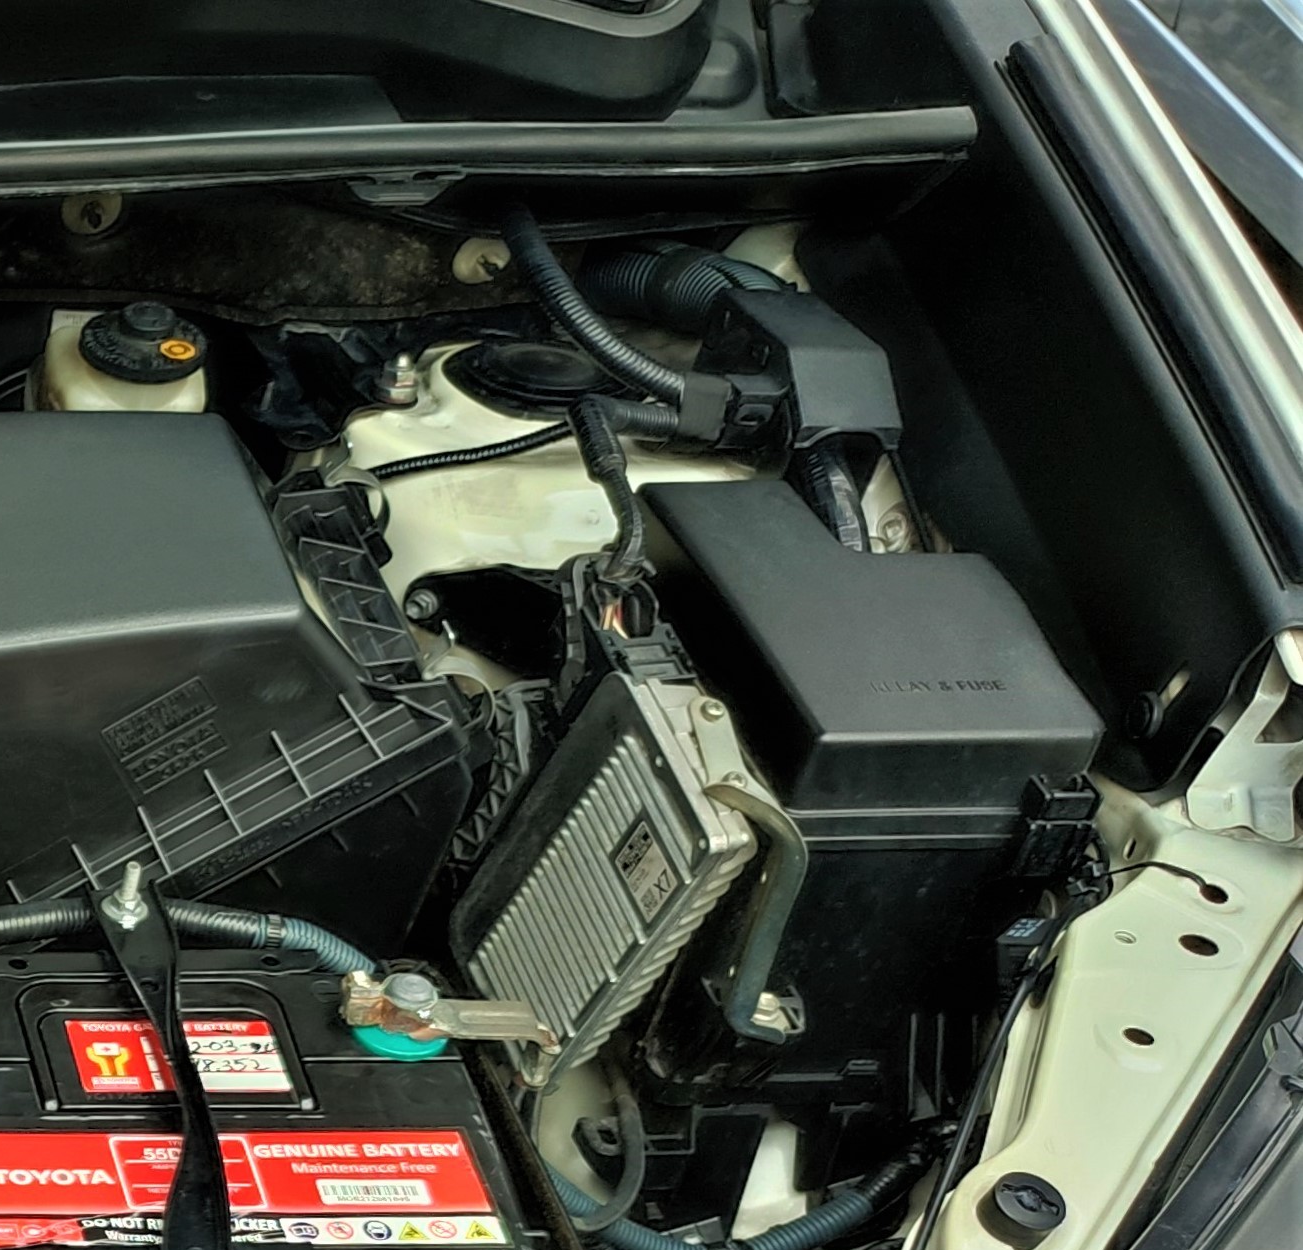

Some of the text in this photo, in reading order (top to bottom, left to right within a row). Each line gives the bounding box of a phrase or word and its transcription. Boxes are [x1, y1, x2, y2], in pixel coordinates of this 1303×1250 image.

[956, 680, 1008, 692] FUSE
[81, 1023, 131, 1033] TOYOTA
[143, 1148, 181, 1160] 55D
[253, 1143, 461, 1159] GENUINE BATTERY
[291, 1161, 437, 1174] Maintenance Free
[110, 1218, 144, 1229] NOT
